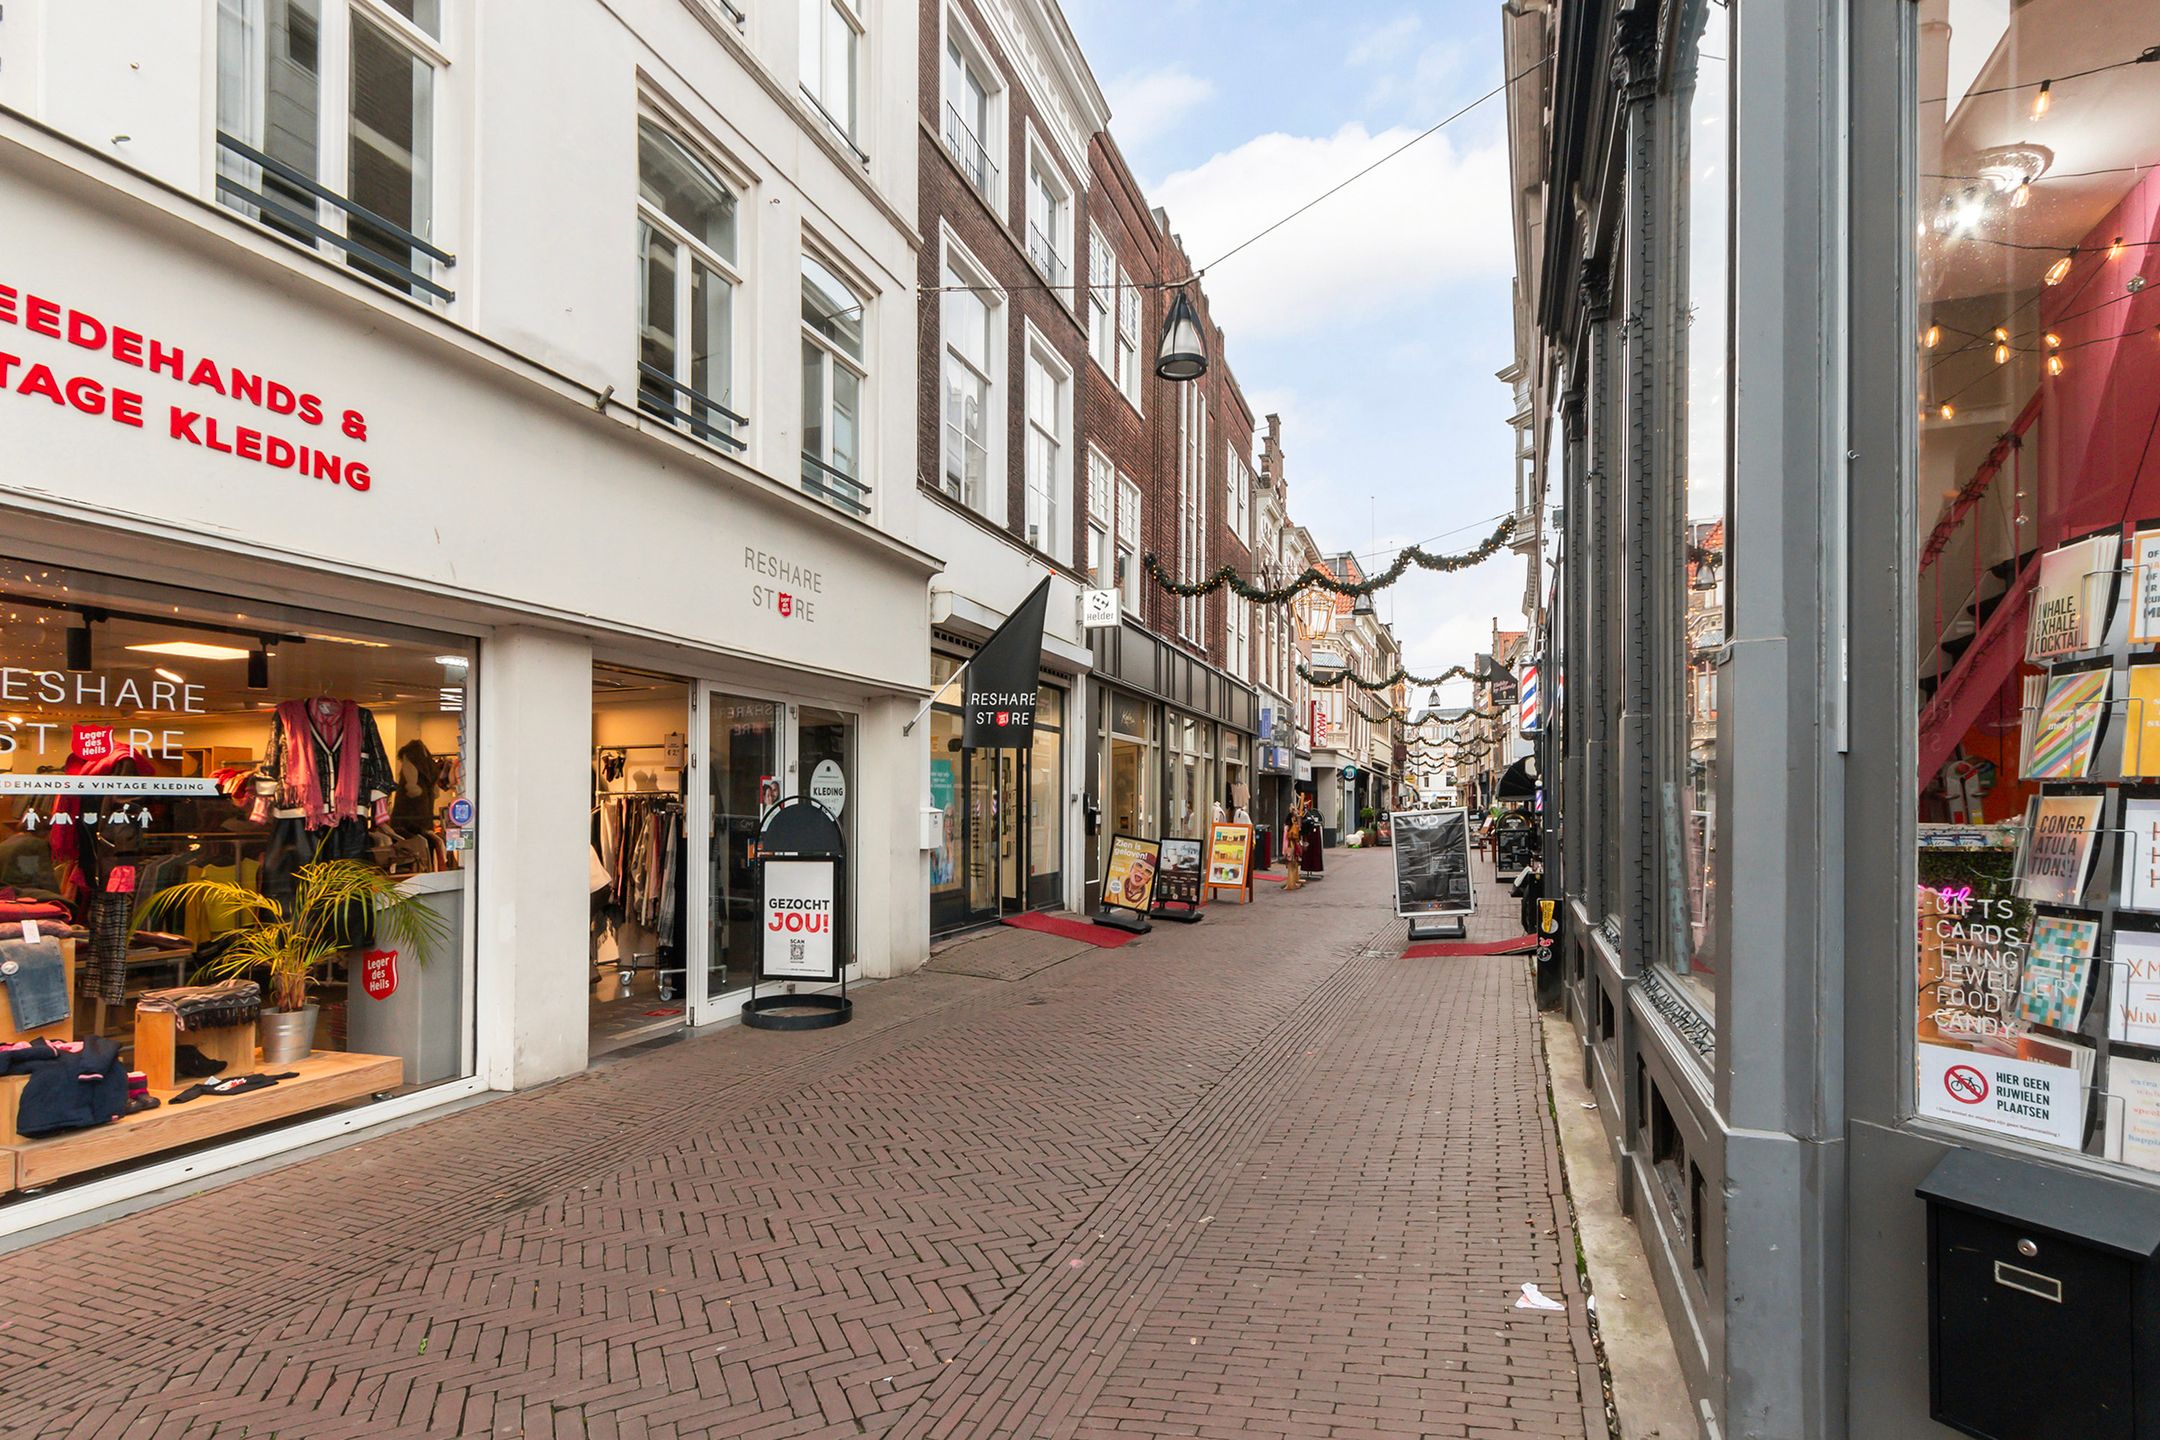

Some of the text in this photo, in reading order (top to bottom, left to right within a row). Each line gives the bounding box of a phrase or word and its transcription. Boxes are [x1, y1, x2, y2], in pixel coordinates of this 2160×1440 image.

[0, 351, 371, 492] TAGE KLEDING
[341, 409, 367, 442] &
[745, 546, 822, 594] RESHARE
[1086, 612, 1114, 621] Helder
[2, 666, 207, 714] ESHARE
[970, 692, 1036, 706] RESHARE
[80, 729, 107, 741] Leger
[84, 738, 102, 748] des
[82, 746, 106, 756] Heils
[92, 782, 148, 790] VINTAGE
[153, 782, 204, 790] KLEDING
[813, 787, 844, 797] KLEDING
[2040, 815, 2086, 834] CONGR
[1115, 839, 1133, 848] Zien
[2035, 836, 2078, 855] ATULA
[1114, 847, 1148, 860] geloven!
[769, 898, 830, 910] GEZOCHT
[1936, 896, 2013, 919] GIFTS
[768, 912, 829, 934] JOU!
[1936, 920, 2020, 947] CARDS
[368, 957, 390, 970] Leger
[1940, 940, 2018, 970] LIVING
[372, 970, 386, 980] des
[370, 978, 390, 992] Heils
[1936, 985, 2000, 1013] FOOD
[1934, 1008, 2015, 1039] CANDY
[1996, 1072, 2050, 1091] HIER GEEN
[1996, 1086, 2050, 1106] RIJWIELEN
[1997, 1100, 2050, 1120] PLAATSEN
